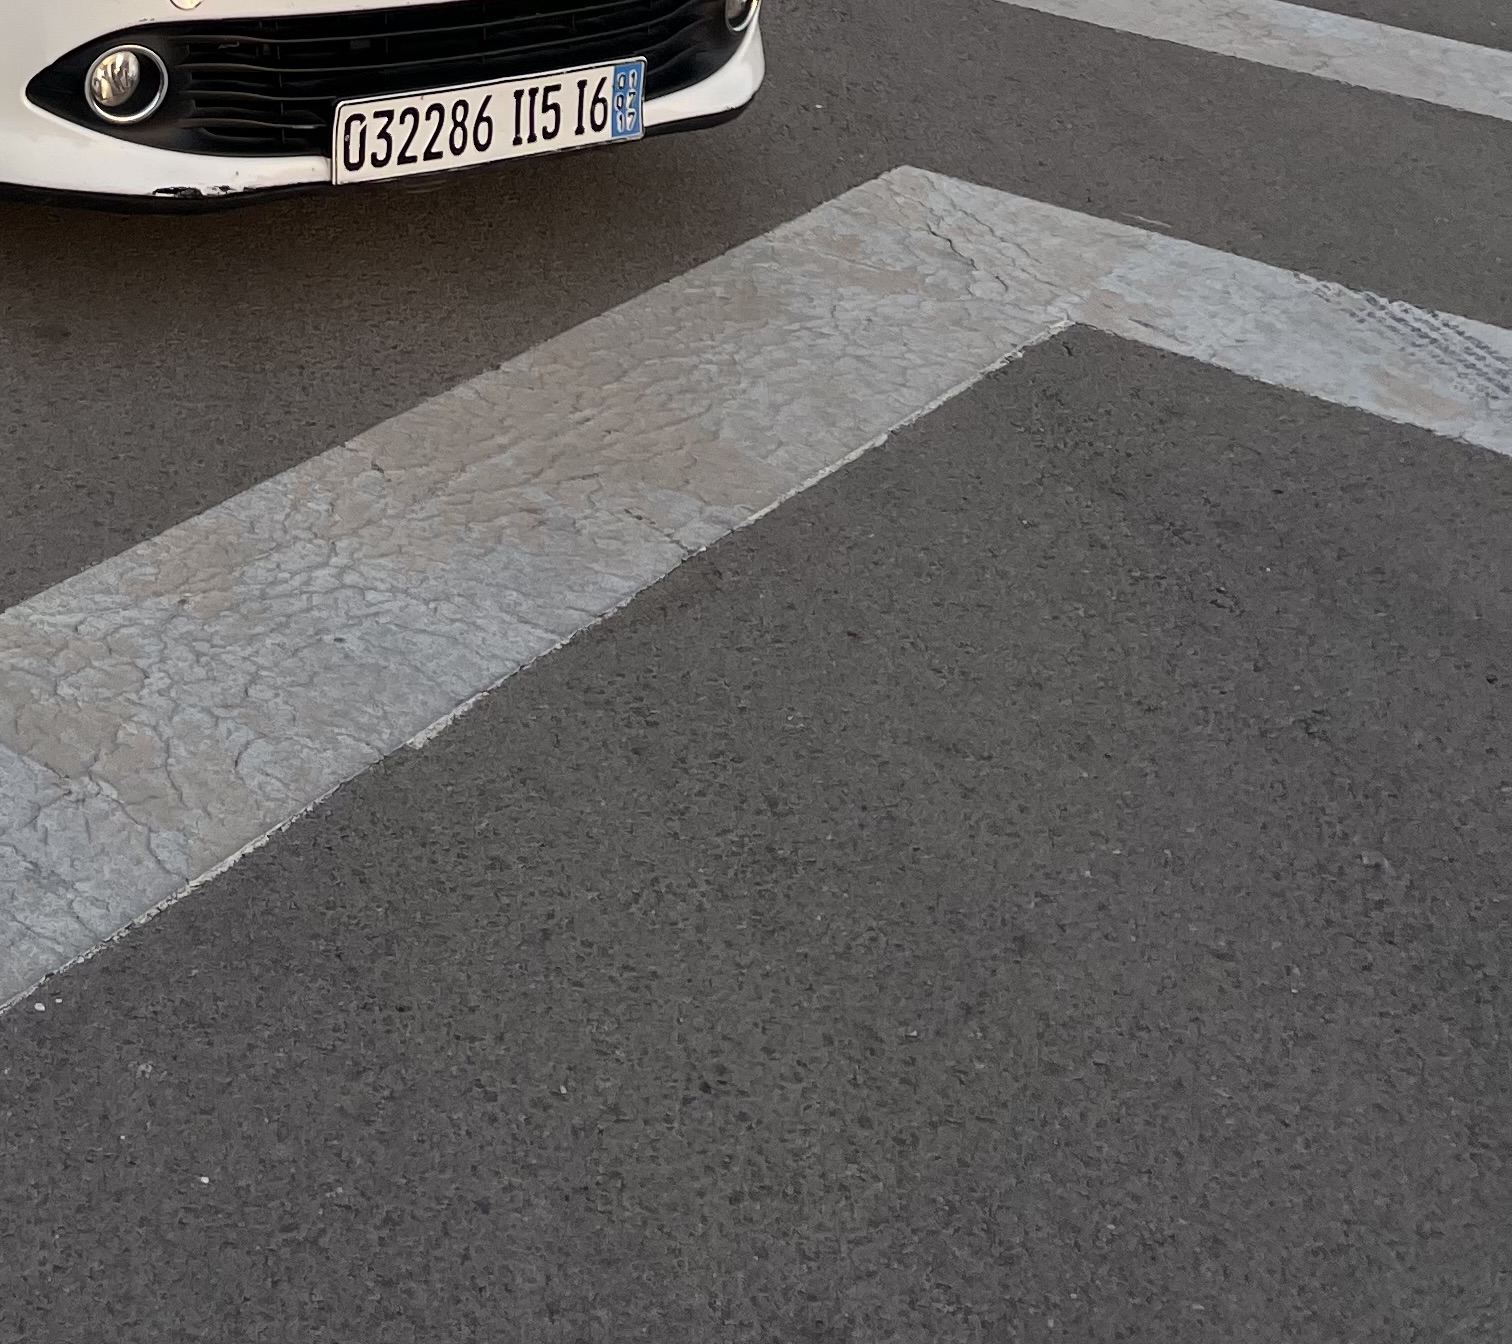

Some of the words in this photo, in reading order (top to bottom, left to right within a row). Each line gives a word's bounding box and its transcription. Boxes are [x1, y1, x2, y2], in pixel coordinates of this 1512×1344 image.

[616, 69, 637, 90] 01
[616, 111, 636, 133] 17
[343, 95, 493, 172] 032286
